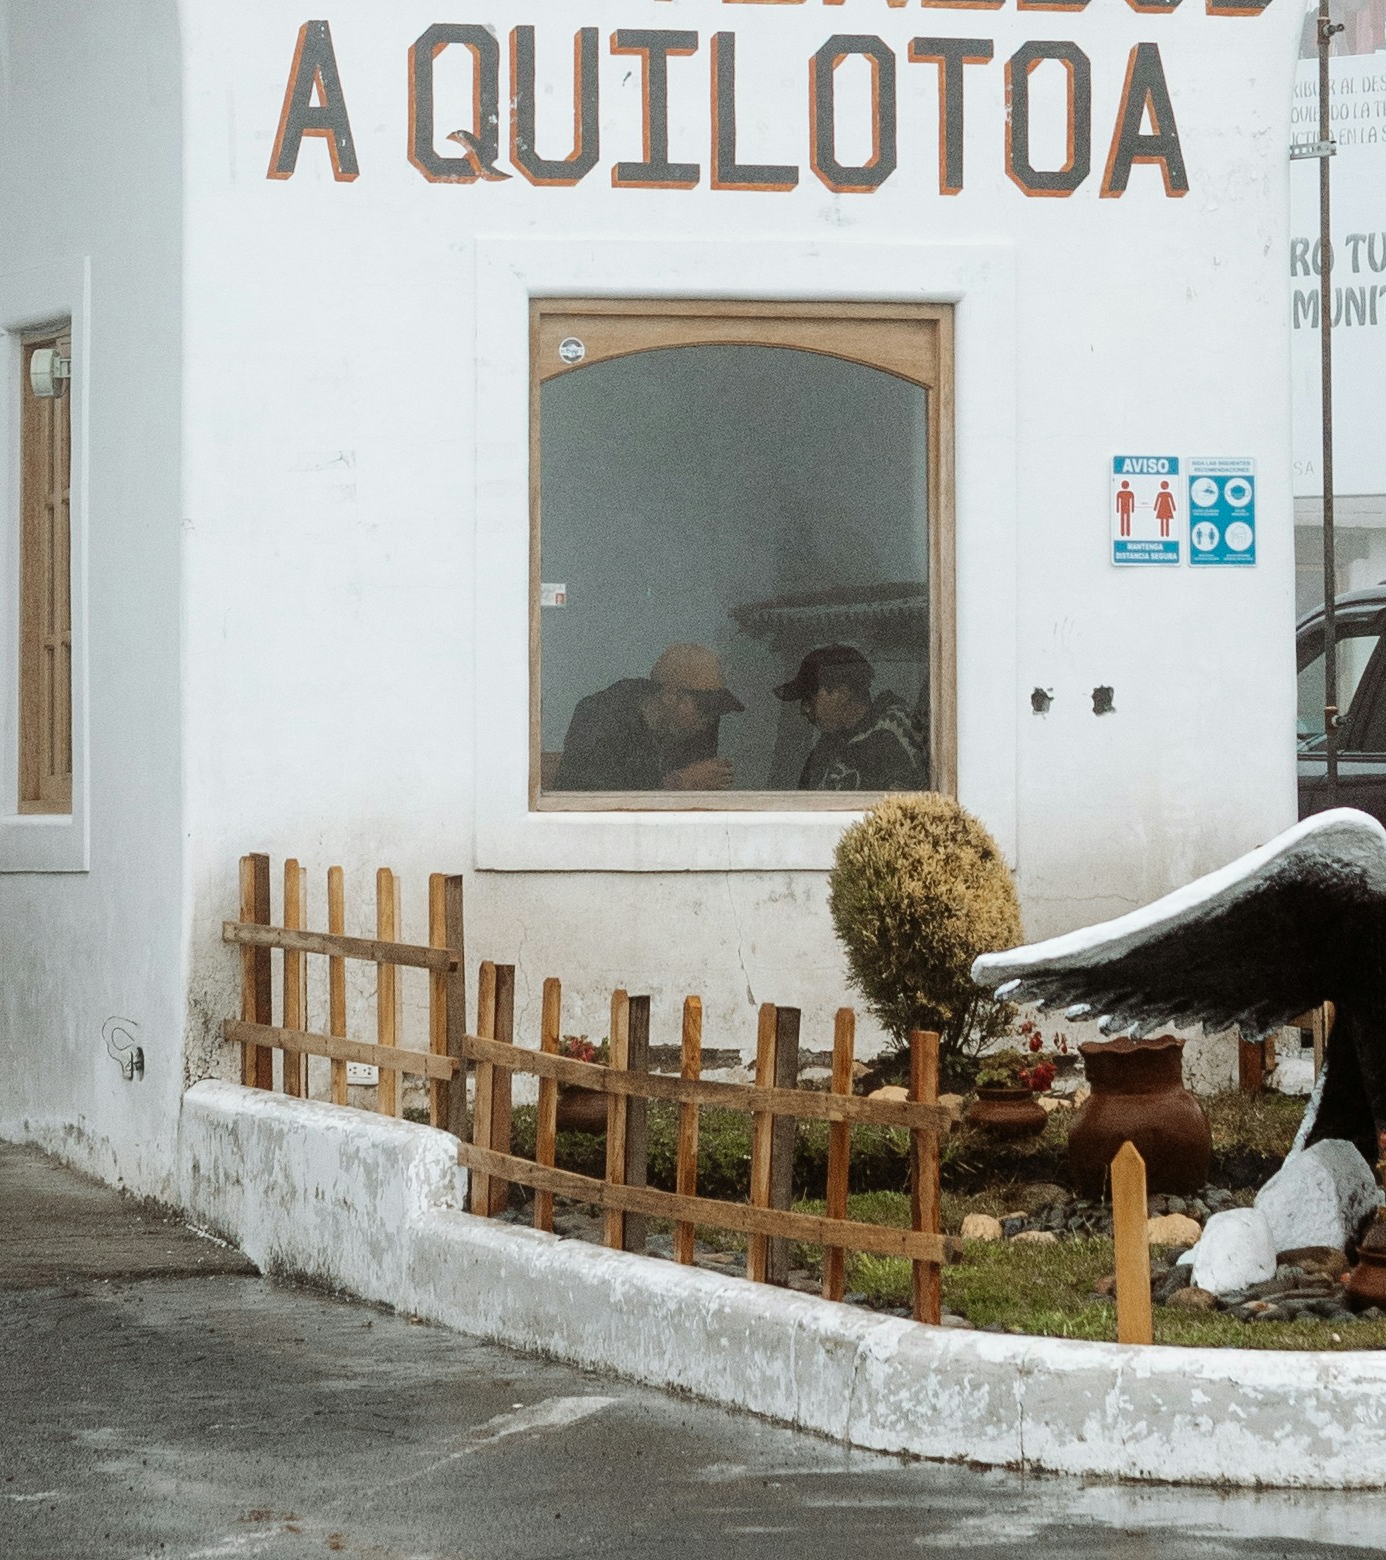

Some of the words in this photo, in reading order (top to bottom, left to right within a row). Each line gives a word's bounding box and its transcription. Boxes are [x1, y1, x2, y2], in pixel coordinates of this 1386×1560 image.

[1340, 77, 1357, 95] AL
[266, 20, 360, 182] A
[407, 23, 1190, 199] QUILOTOA
[1353, 99, 1370, 119] LA
[1339, 127, 1358, 145] EN
[1361, 126, 1377, 143] LA
[1122, 459, 1169, 473] AVISO
